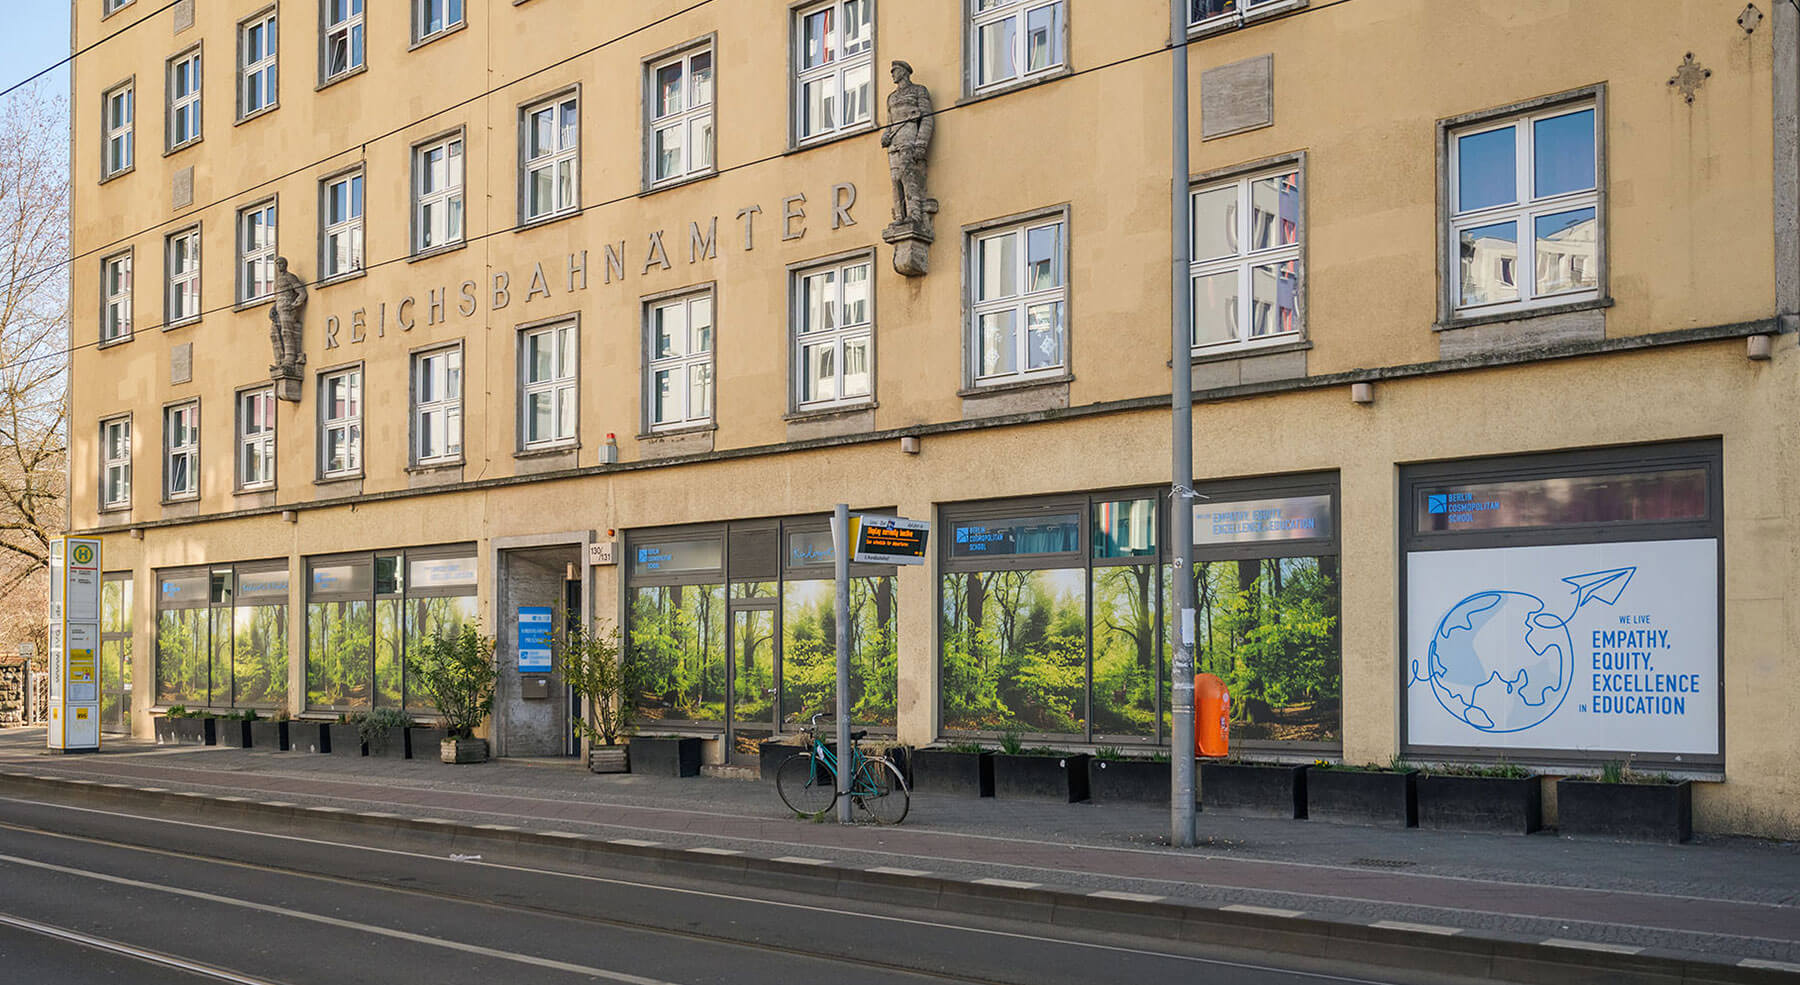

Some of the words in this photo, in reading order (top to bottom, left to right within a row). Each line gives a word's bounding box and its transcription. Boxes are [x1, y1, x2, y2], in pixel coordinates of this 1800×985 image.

[324, 182, 858, 350] REICHSBAHNÄMTER
[1448, 493, 1473, 502] BERLIN
[1448, 501, 1500, 512] COSMOPOLITAN
[1448, 514, 1473, 523] SCHOOL
[1619, 615, 1631, 624] WE
[1633, 614, 1651, 624] LIVE
[1592, 629, 1671, 650] EMPATHY,
[1592, 652, 1654, 671] EQUITY,
[1592, 674, 1700, 693] EXCELLENCE
[1578, 703, 1587, 713] IN
[1592, 695, 1685, 715] EDUCATION
